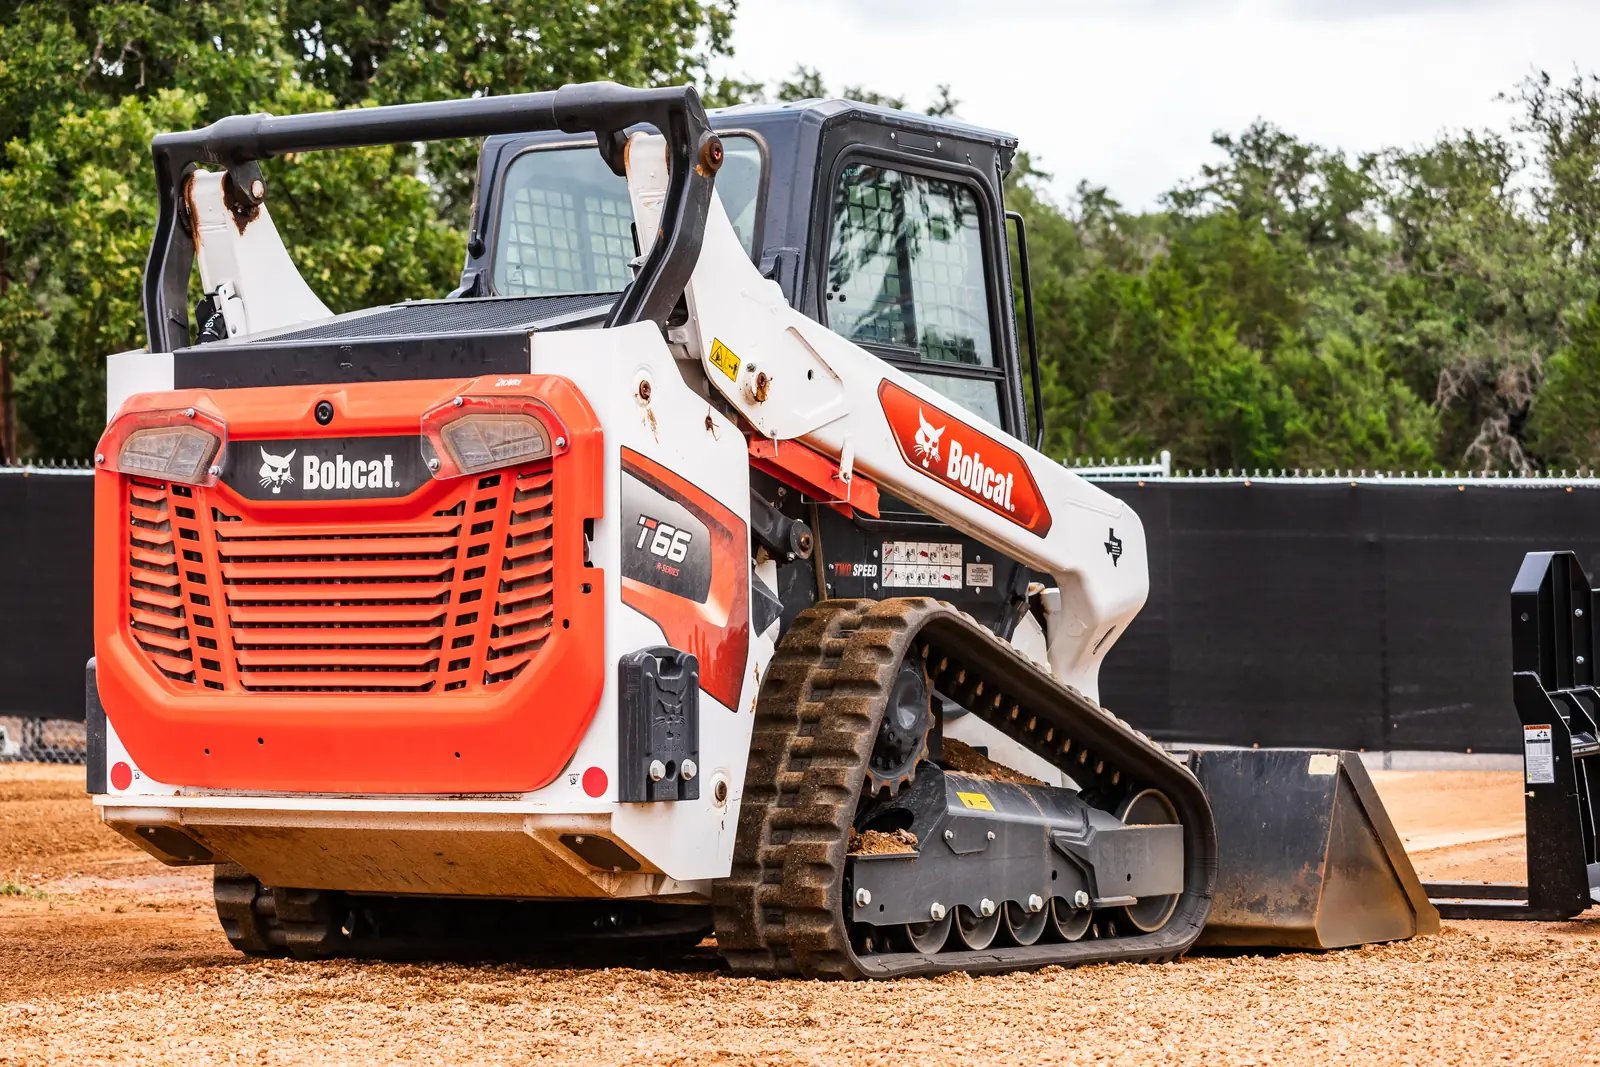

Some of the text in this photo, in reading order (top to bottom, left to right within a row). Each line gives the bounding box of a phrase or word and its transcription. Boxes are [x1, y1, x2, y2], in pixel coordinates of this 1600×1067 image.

[303, 454, 393, 490] Bobcat
[947, 439, 1013, 511] Bobcat
[635, 514, 693, 565] T66
[834, 563, 878, 578] TWO SPEED
